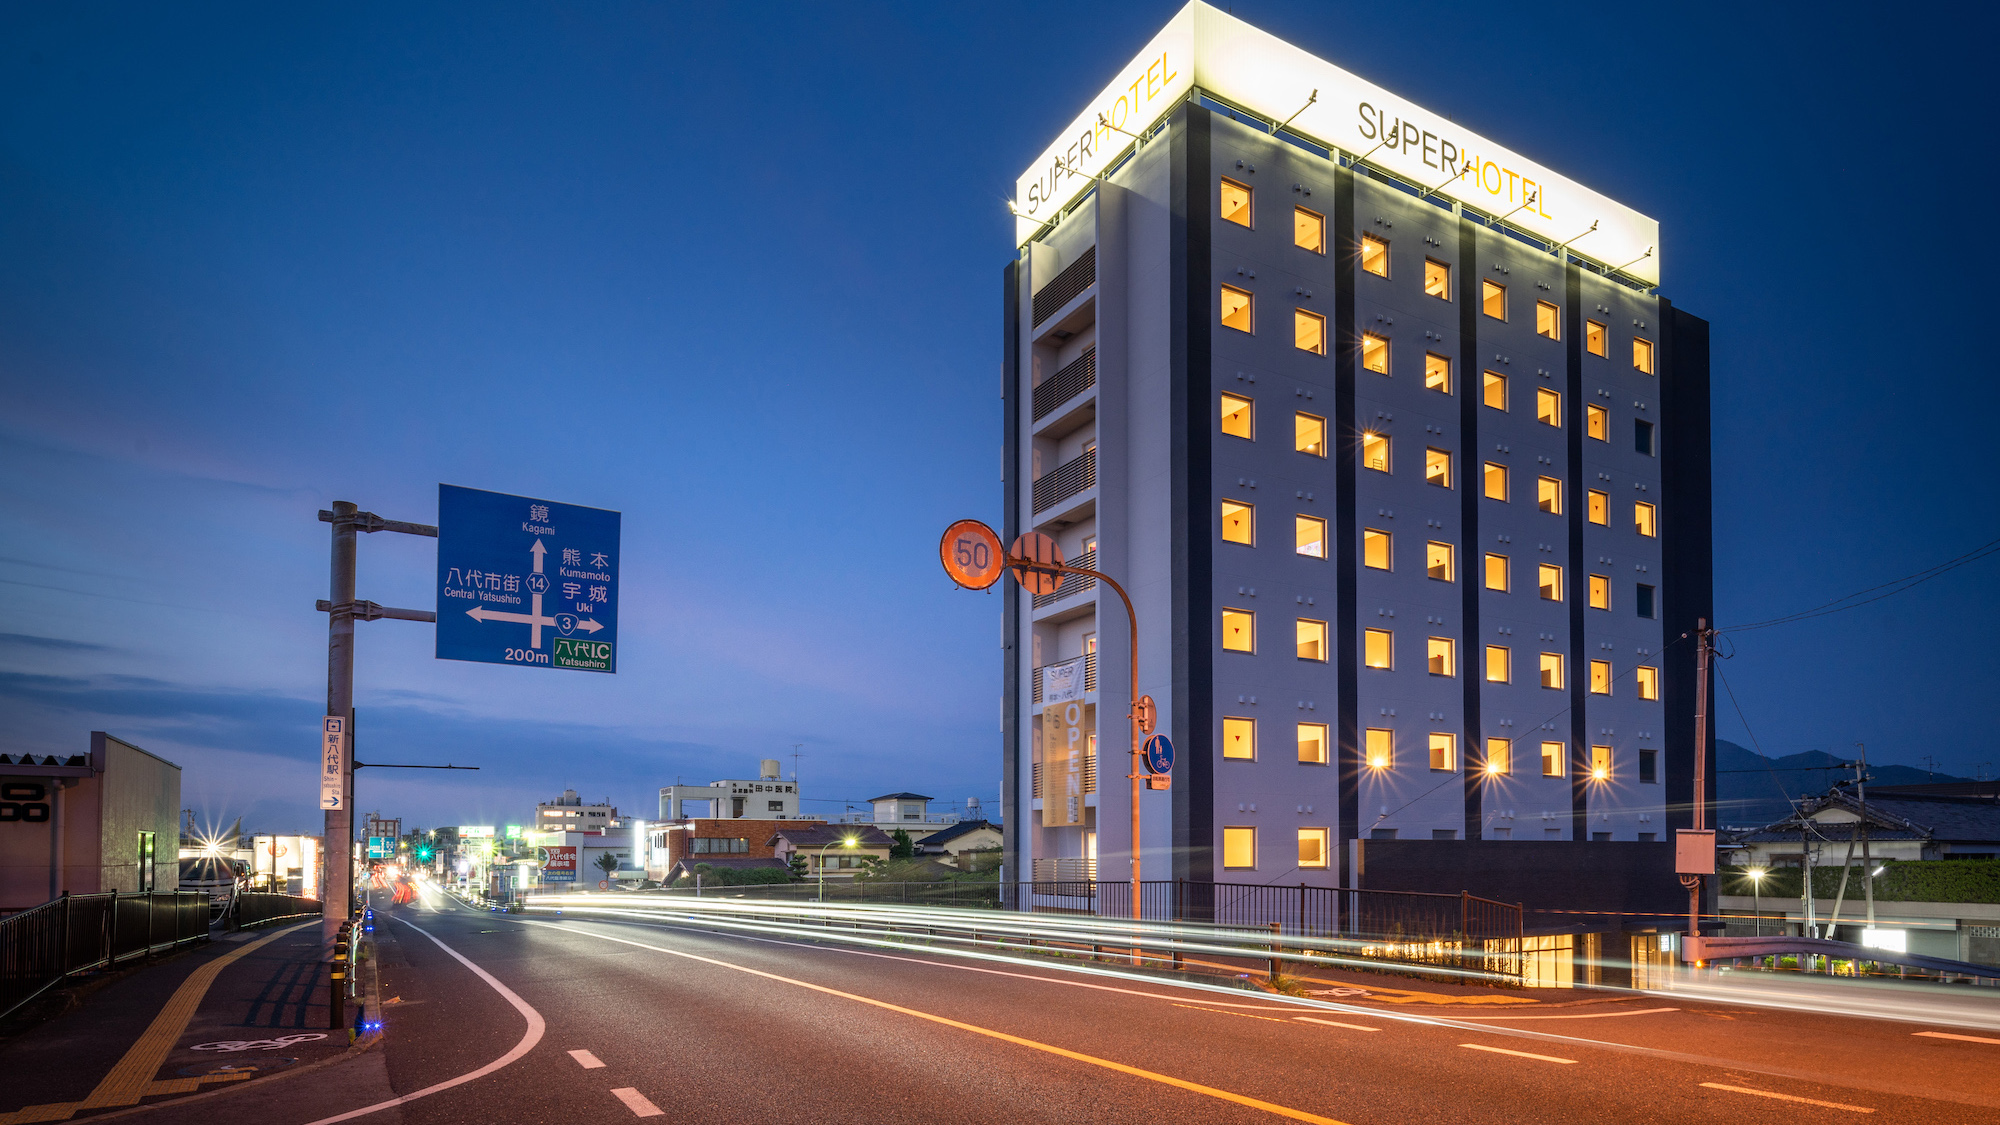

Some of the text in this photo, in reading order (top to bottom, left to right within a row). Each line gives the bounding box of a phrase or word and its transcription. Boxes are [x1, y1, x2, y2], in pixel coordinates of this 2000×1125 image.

[530, 504, 549, 523] 鏡
[522, 522, 555, 536] Kagami
[957, 539, 989, 570] 50
[446, 567, 521, 593] 八代市街
[559, 567, 611, 582] Kumamoto
[530, 576, 544, 591] 14
[444, 587, 521, 605] Central Yatsushiro
[576, 602, 593, 613] Uki
[562, 618, 572, 630] 3
[505, 648, 549, 664] 200m
[559, 656, 606, 669] Yatsushiro
[326, 733, 339, 775] 新八代駅
[1065, 703, 1081, 796] OPEN
[755, 784, 793, 793] 田中医院
[551, 852, 576, 860] 八代住宅
